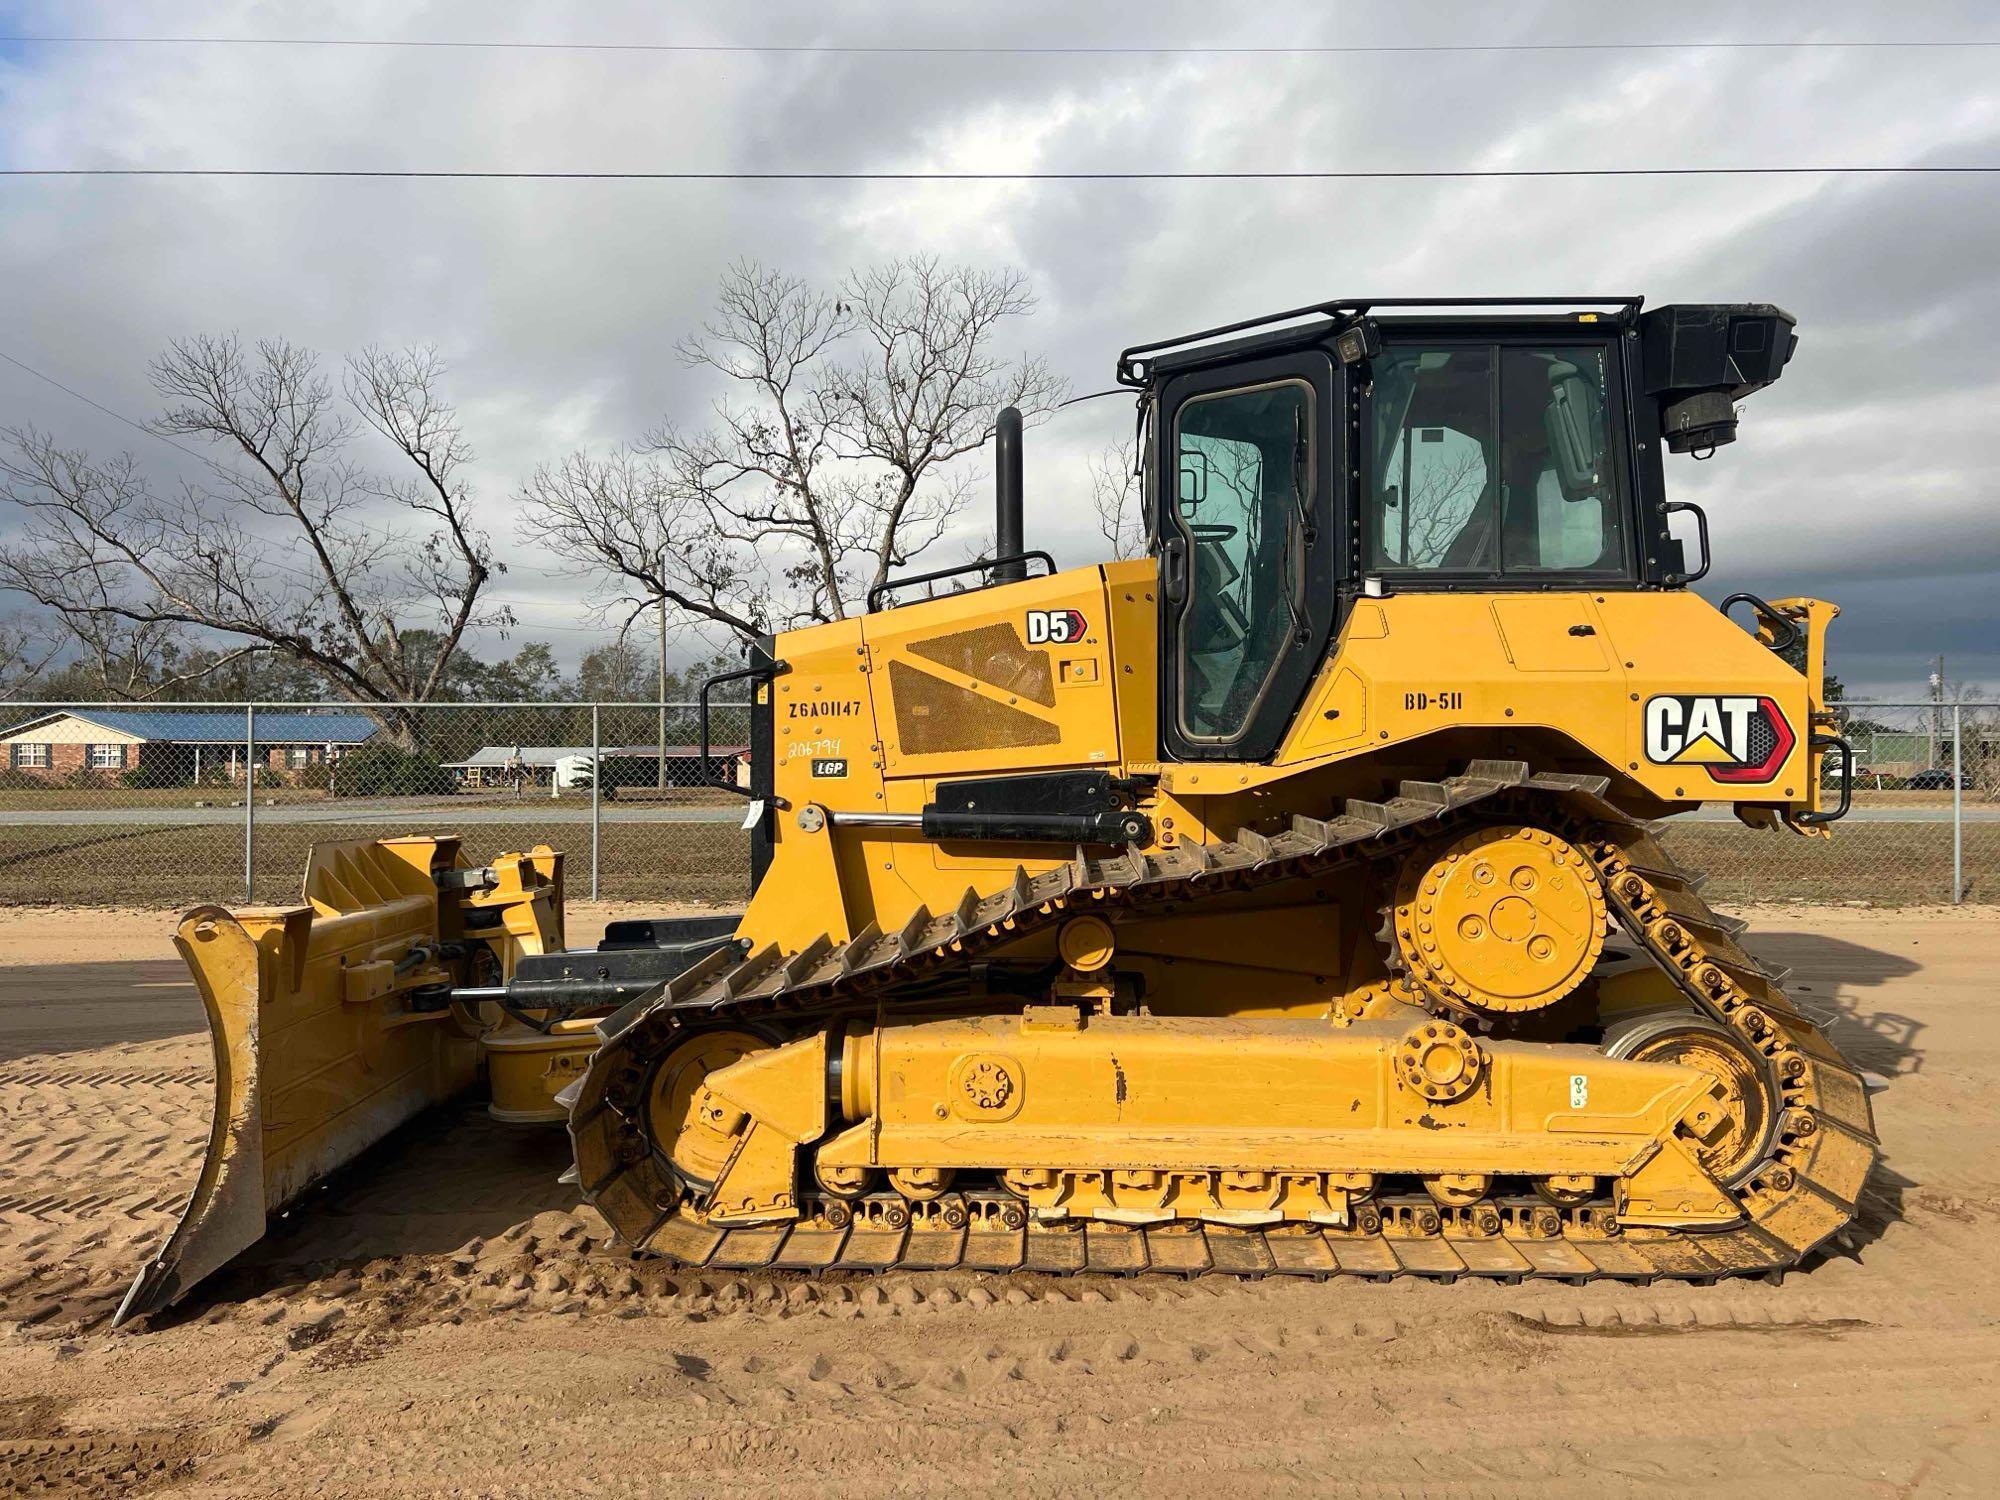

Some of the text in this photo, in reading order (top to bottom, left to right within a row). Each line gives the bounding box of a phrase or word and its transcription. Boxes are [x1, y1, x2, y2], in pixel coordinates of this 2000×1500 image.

[1028, 611, 1069, 642] D5
[789, 701, 861, 718] Z6A01147
[1405, 692, 1462, 710] BD-511
[1647, 697, 1757, 762] CAT
[788, 738, 841, 759] 206794
[817, 762, 844, 775] LGP
